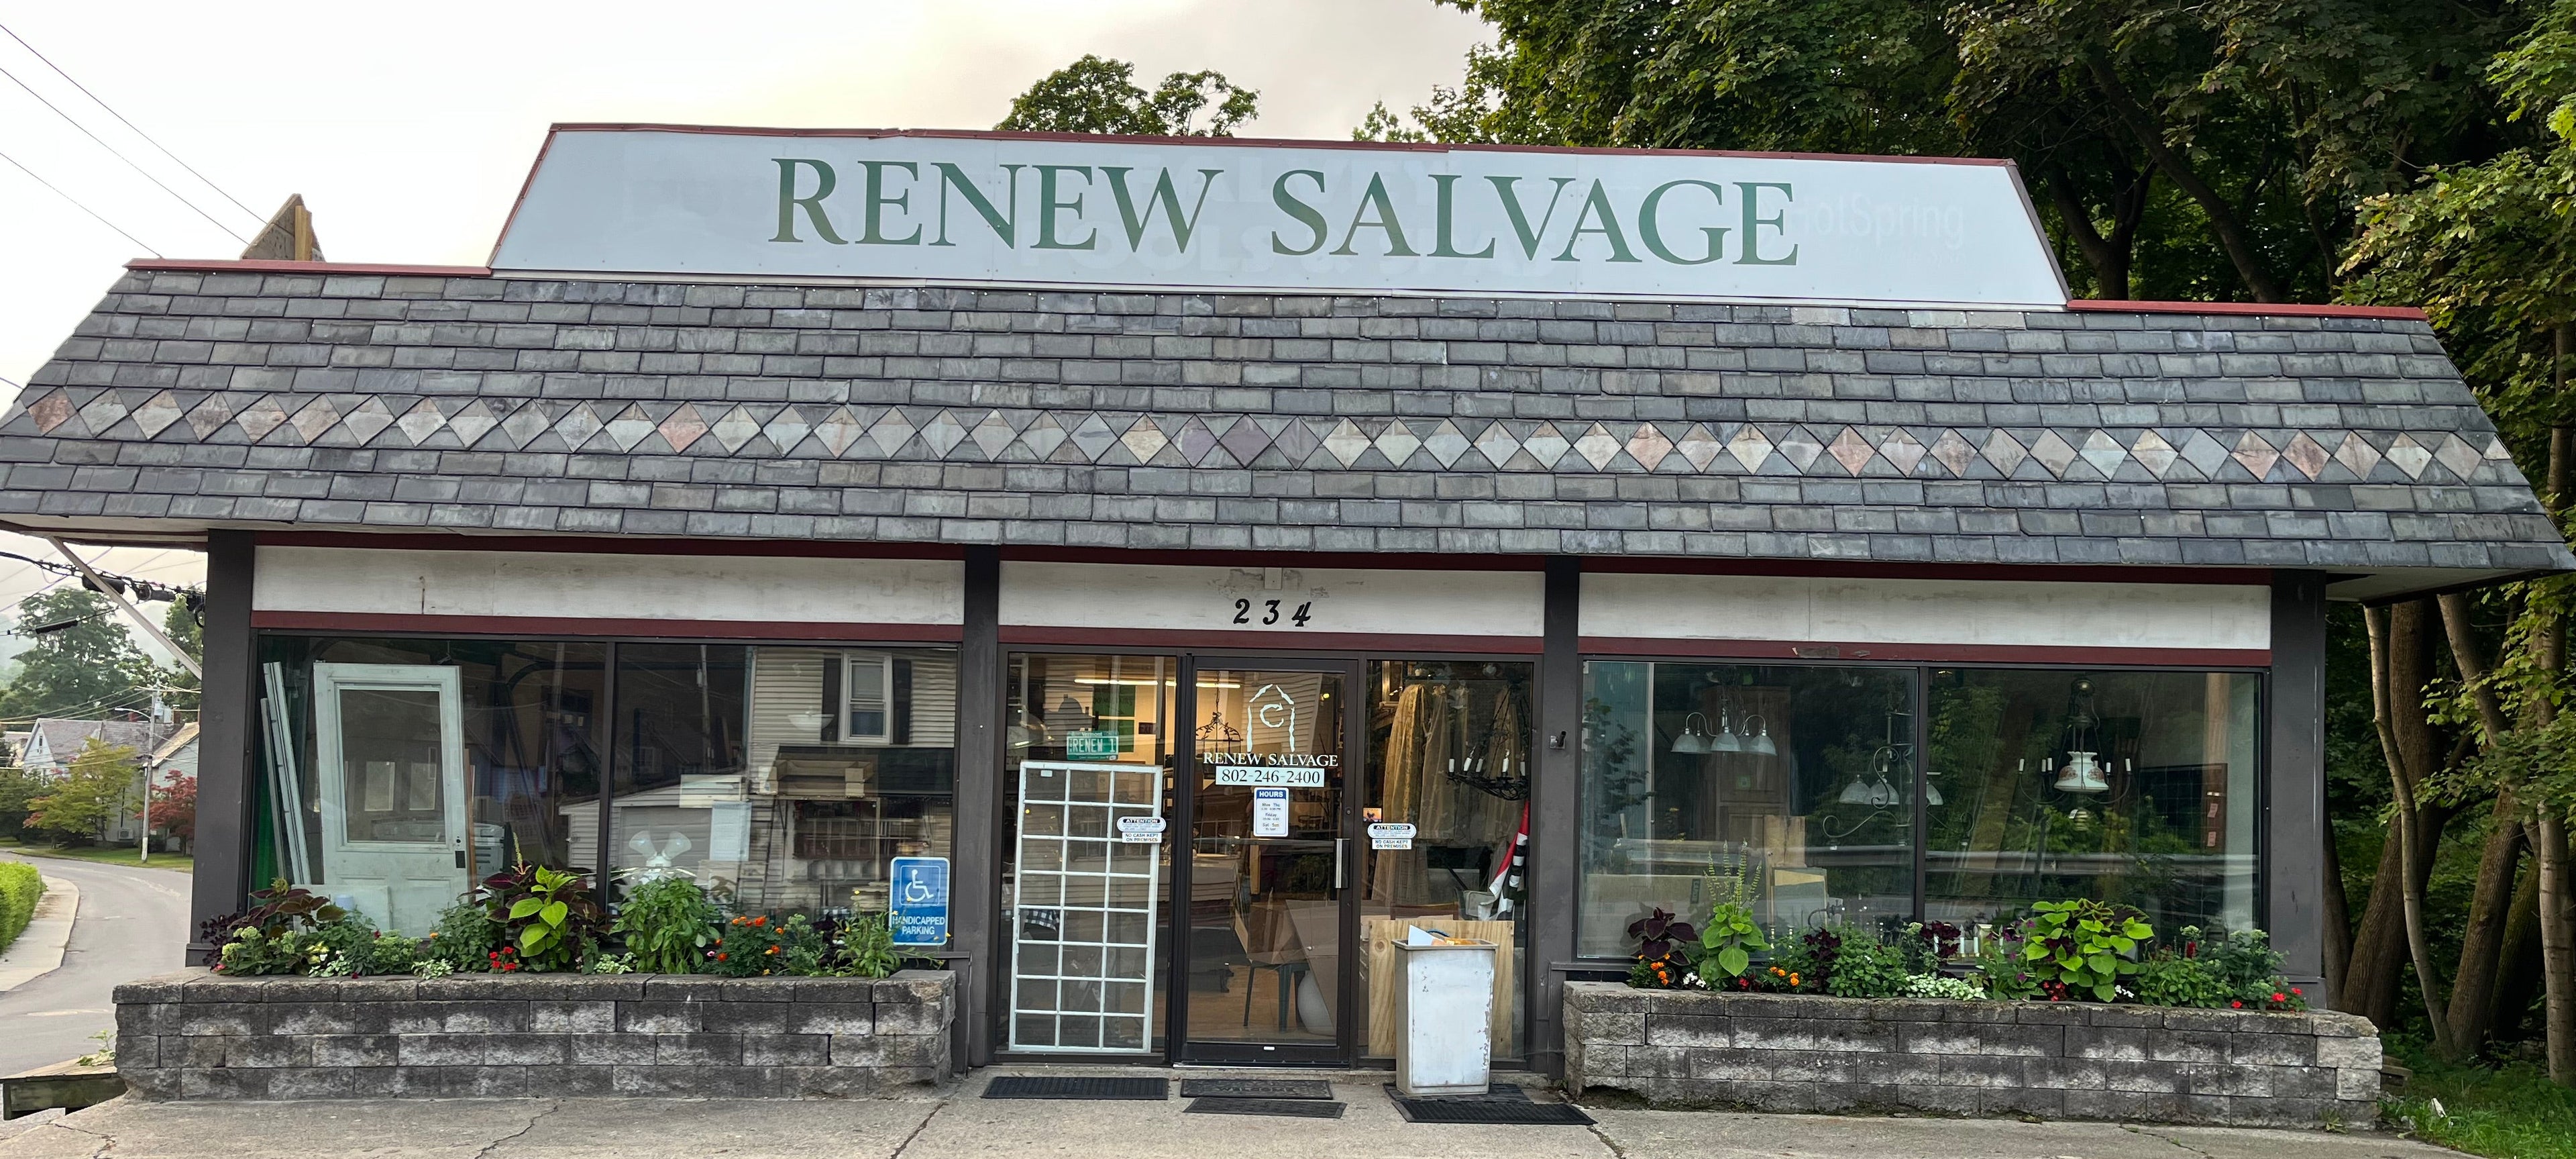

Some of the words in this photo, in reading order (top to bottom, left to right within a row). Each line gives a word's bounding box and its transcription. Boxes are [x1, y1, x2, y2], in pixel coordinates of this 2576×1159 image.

[768, 157, 1224, 254] RENEW
[1271, 168, 1799, 266] SALVAGE
[1232, 598, 1312, 627] 234
[1073, 738, 1103, 752] RENEW
[1203, 752, 1263, 765] RENEW
[1269, 753, 1339, 767] SALVAGE
[1221, 768, 1320, 784] 802-246-2400
[892, 915, 946, 925] HANDICAPPED
[902, 926, 935, 935] PARKING
